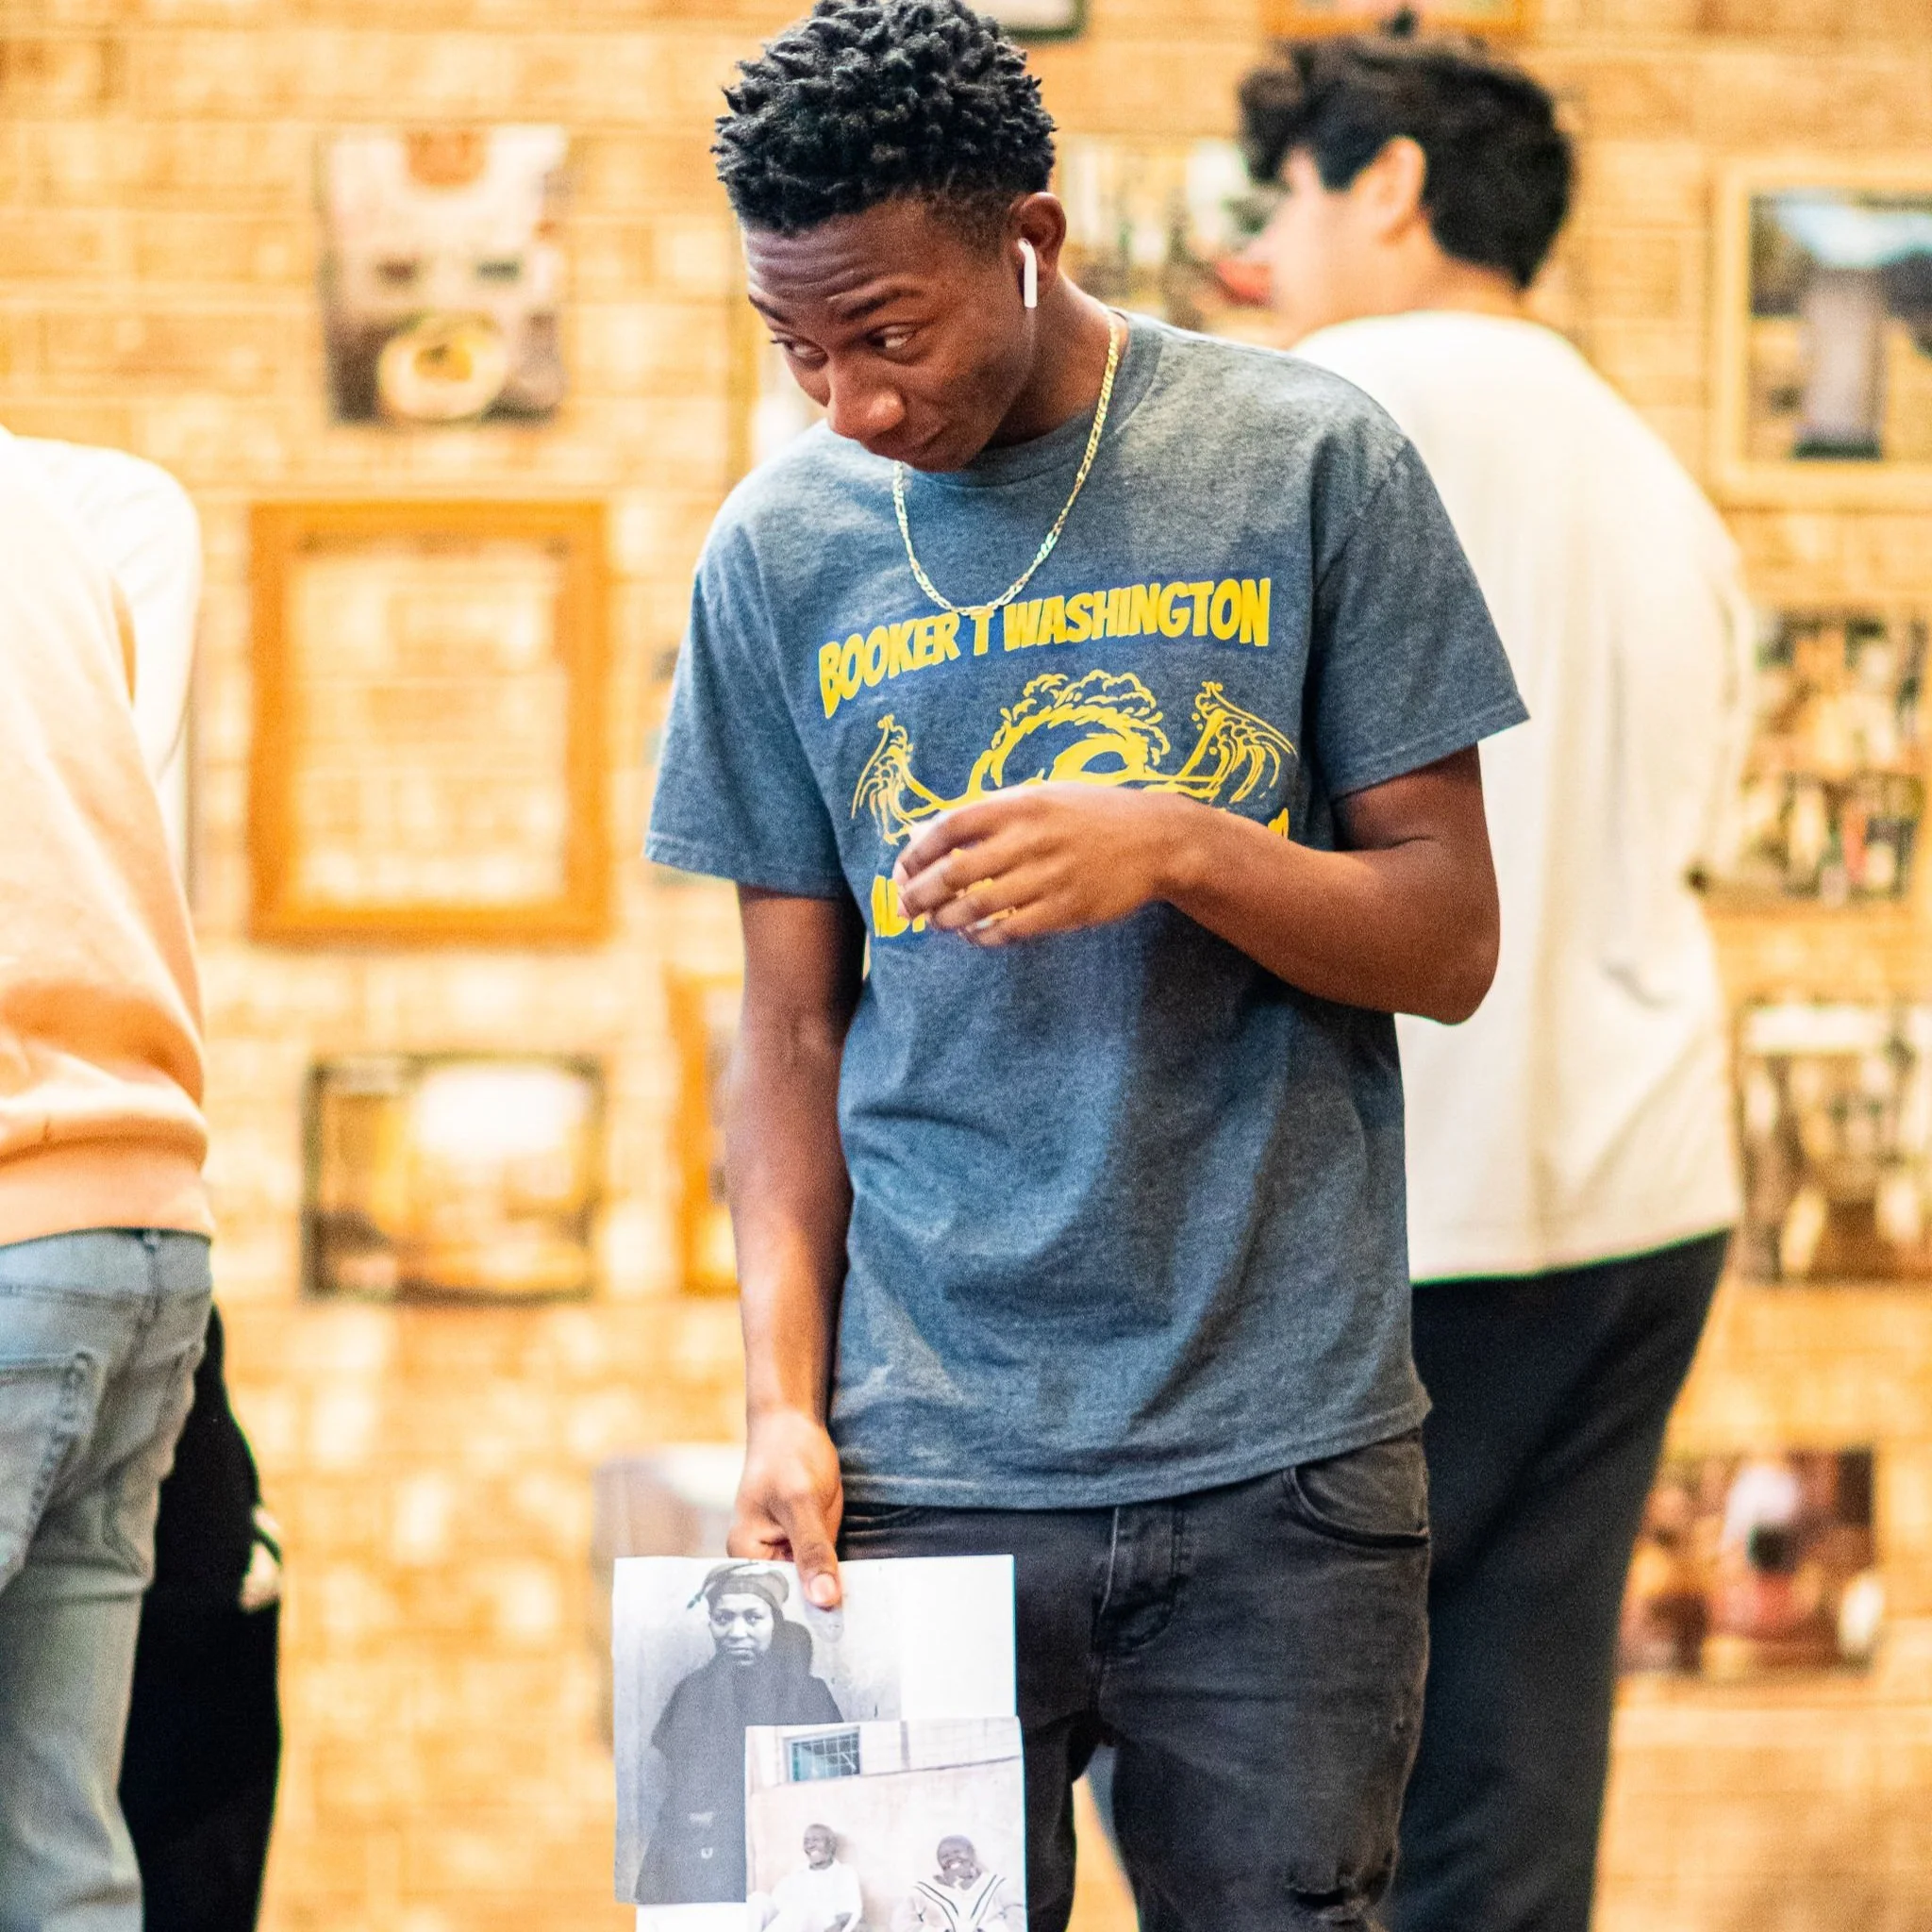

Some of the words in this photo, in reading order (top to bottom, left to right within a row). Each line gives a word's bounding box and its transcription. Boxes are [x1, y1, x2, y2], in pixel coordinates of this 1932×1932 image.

[819, 612, 961, 718] BOOKER
[973, 608, 995, 657] T
[1003, 577, 1272, 652] WASHINGTON
